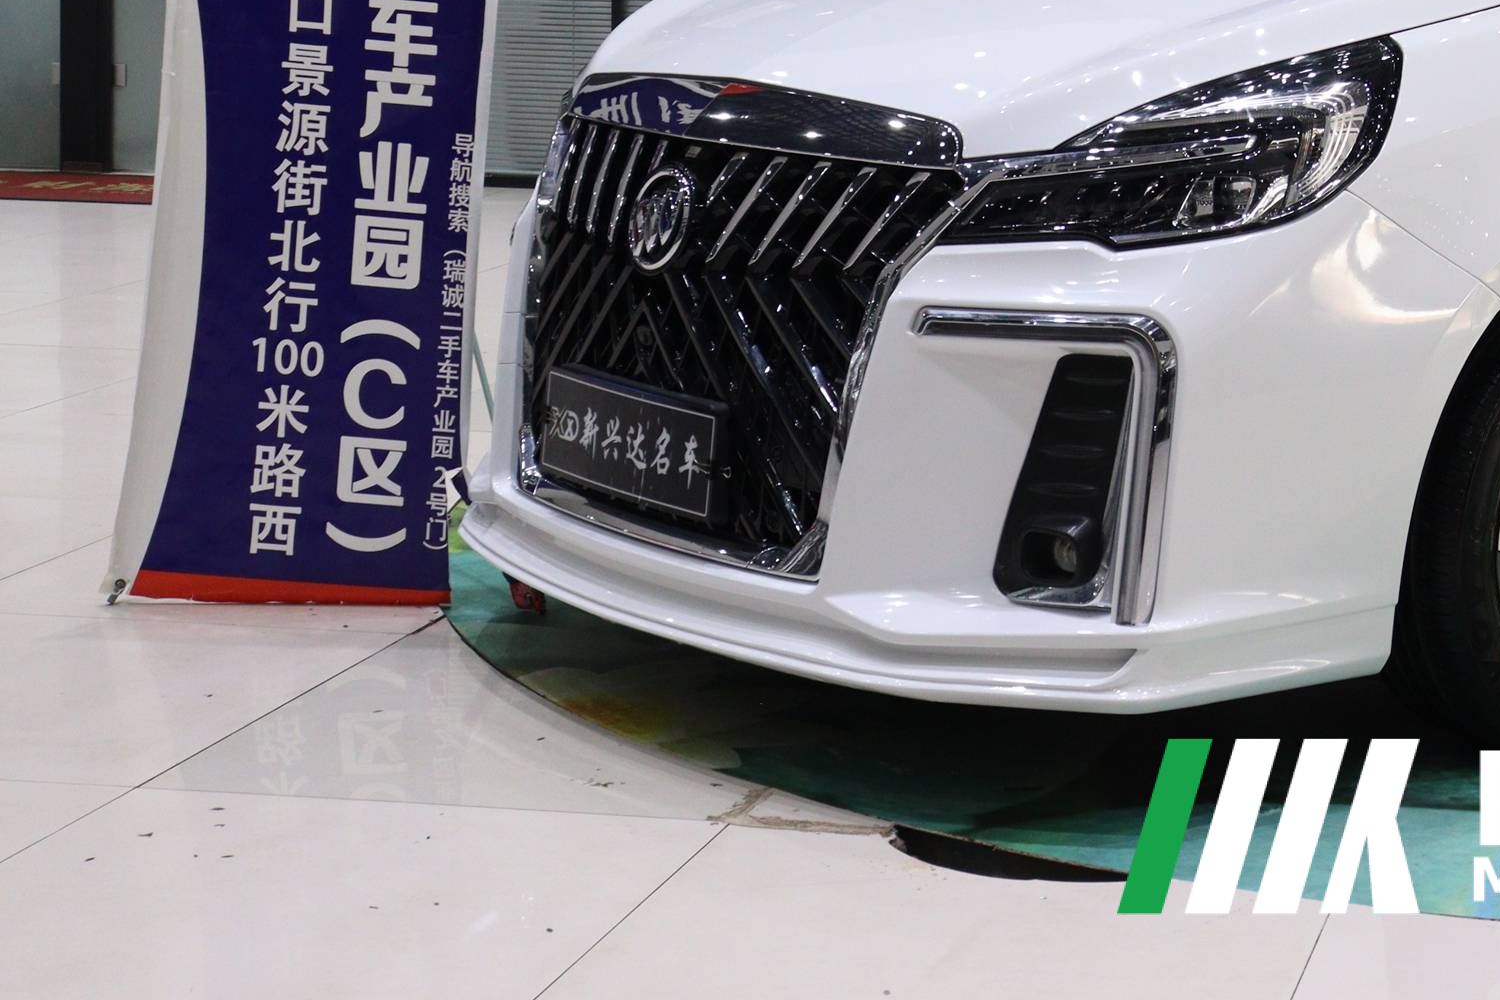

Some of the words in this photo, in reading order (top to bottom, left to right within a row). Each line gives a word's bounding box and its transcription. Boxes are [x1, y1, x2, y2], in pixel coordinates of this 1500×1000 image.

[579, 407, 701, 489] 新兴达名车
